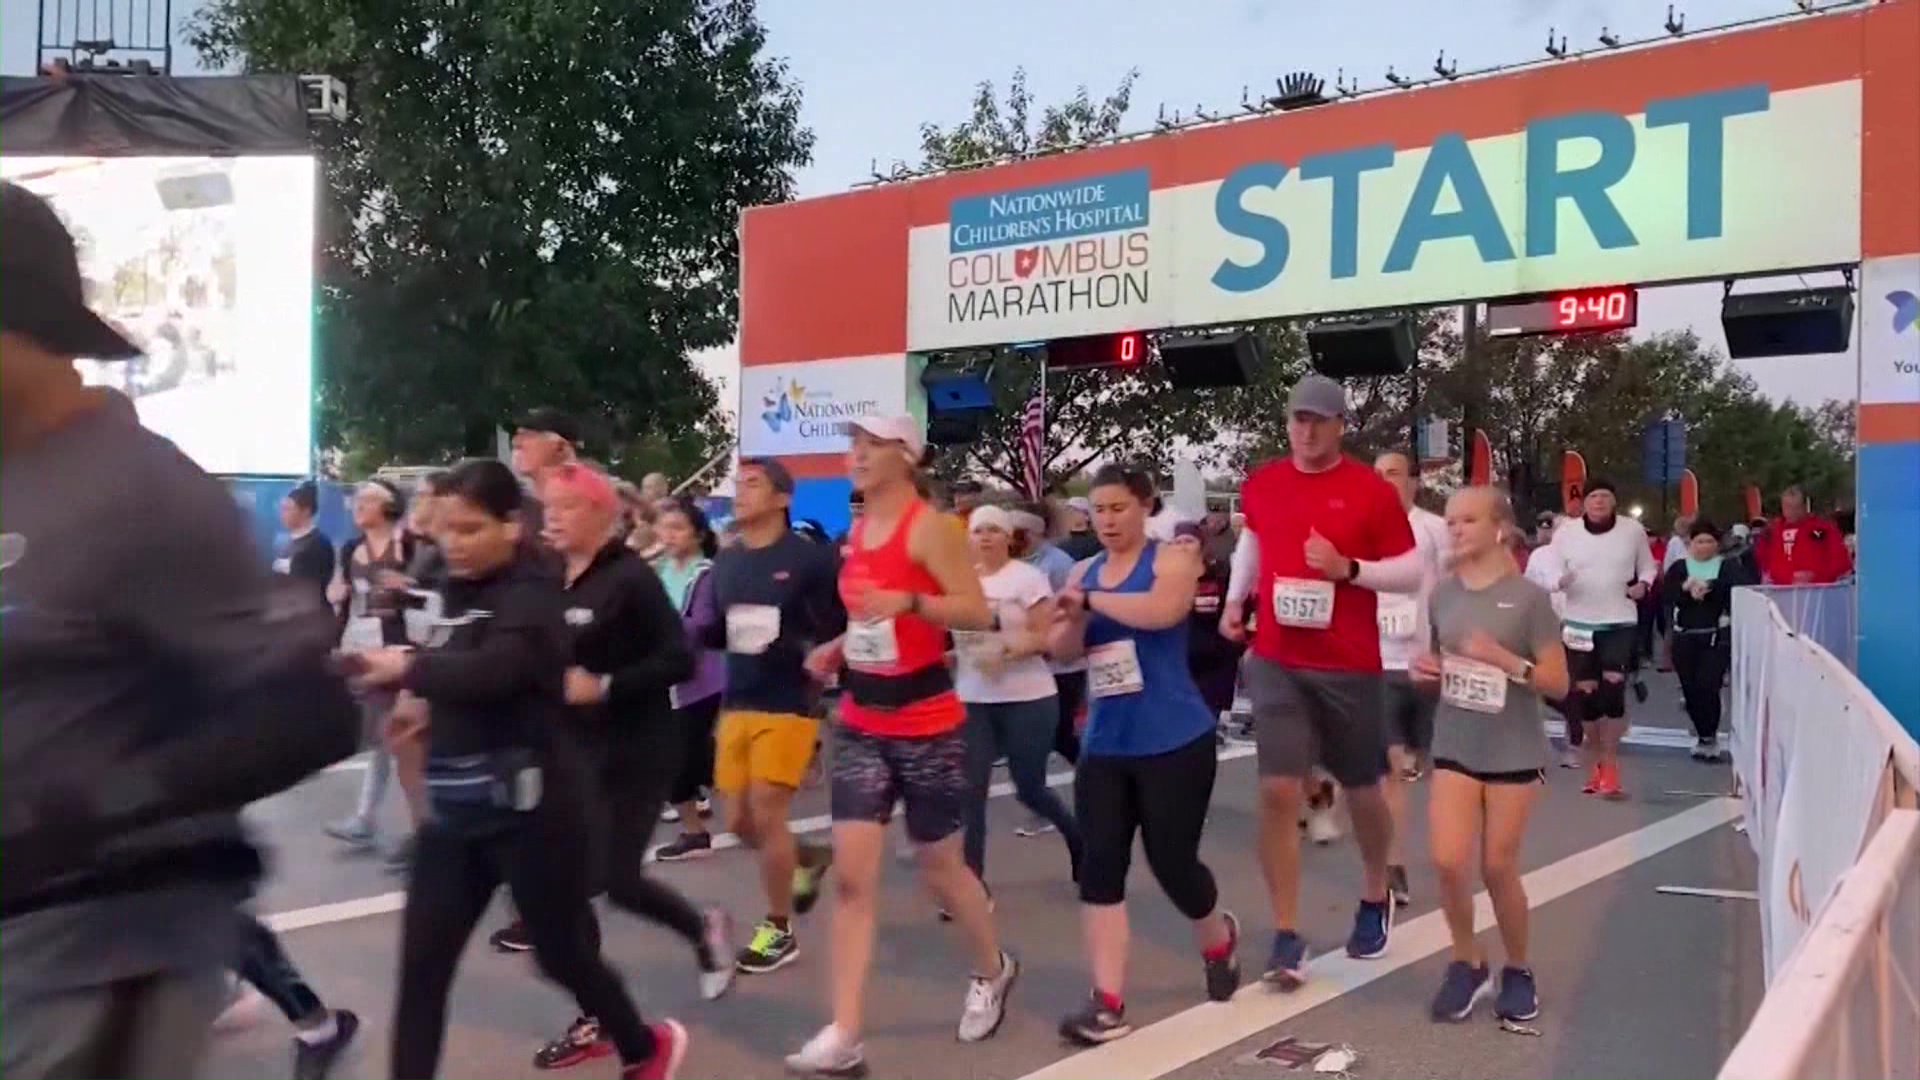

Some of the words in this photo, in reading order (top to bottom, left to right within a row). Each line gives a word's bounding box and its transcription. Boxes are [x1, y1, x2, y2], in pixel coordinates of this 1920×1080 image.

[989, 185, 1106, 218] NATIONWIDE
[1211, 82, 1771, 292] START
[953, 217, 1051, 246] CHILDREN'S
[1055, 203, 1144, 232] HOSPITAL
[948, 270, 1149, 323] MARATHON
